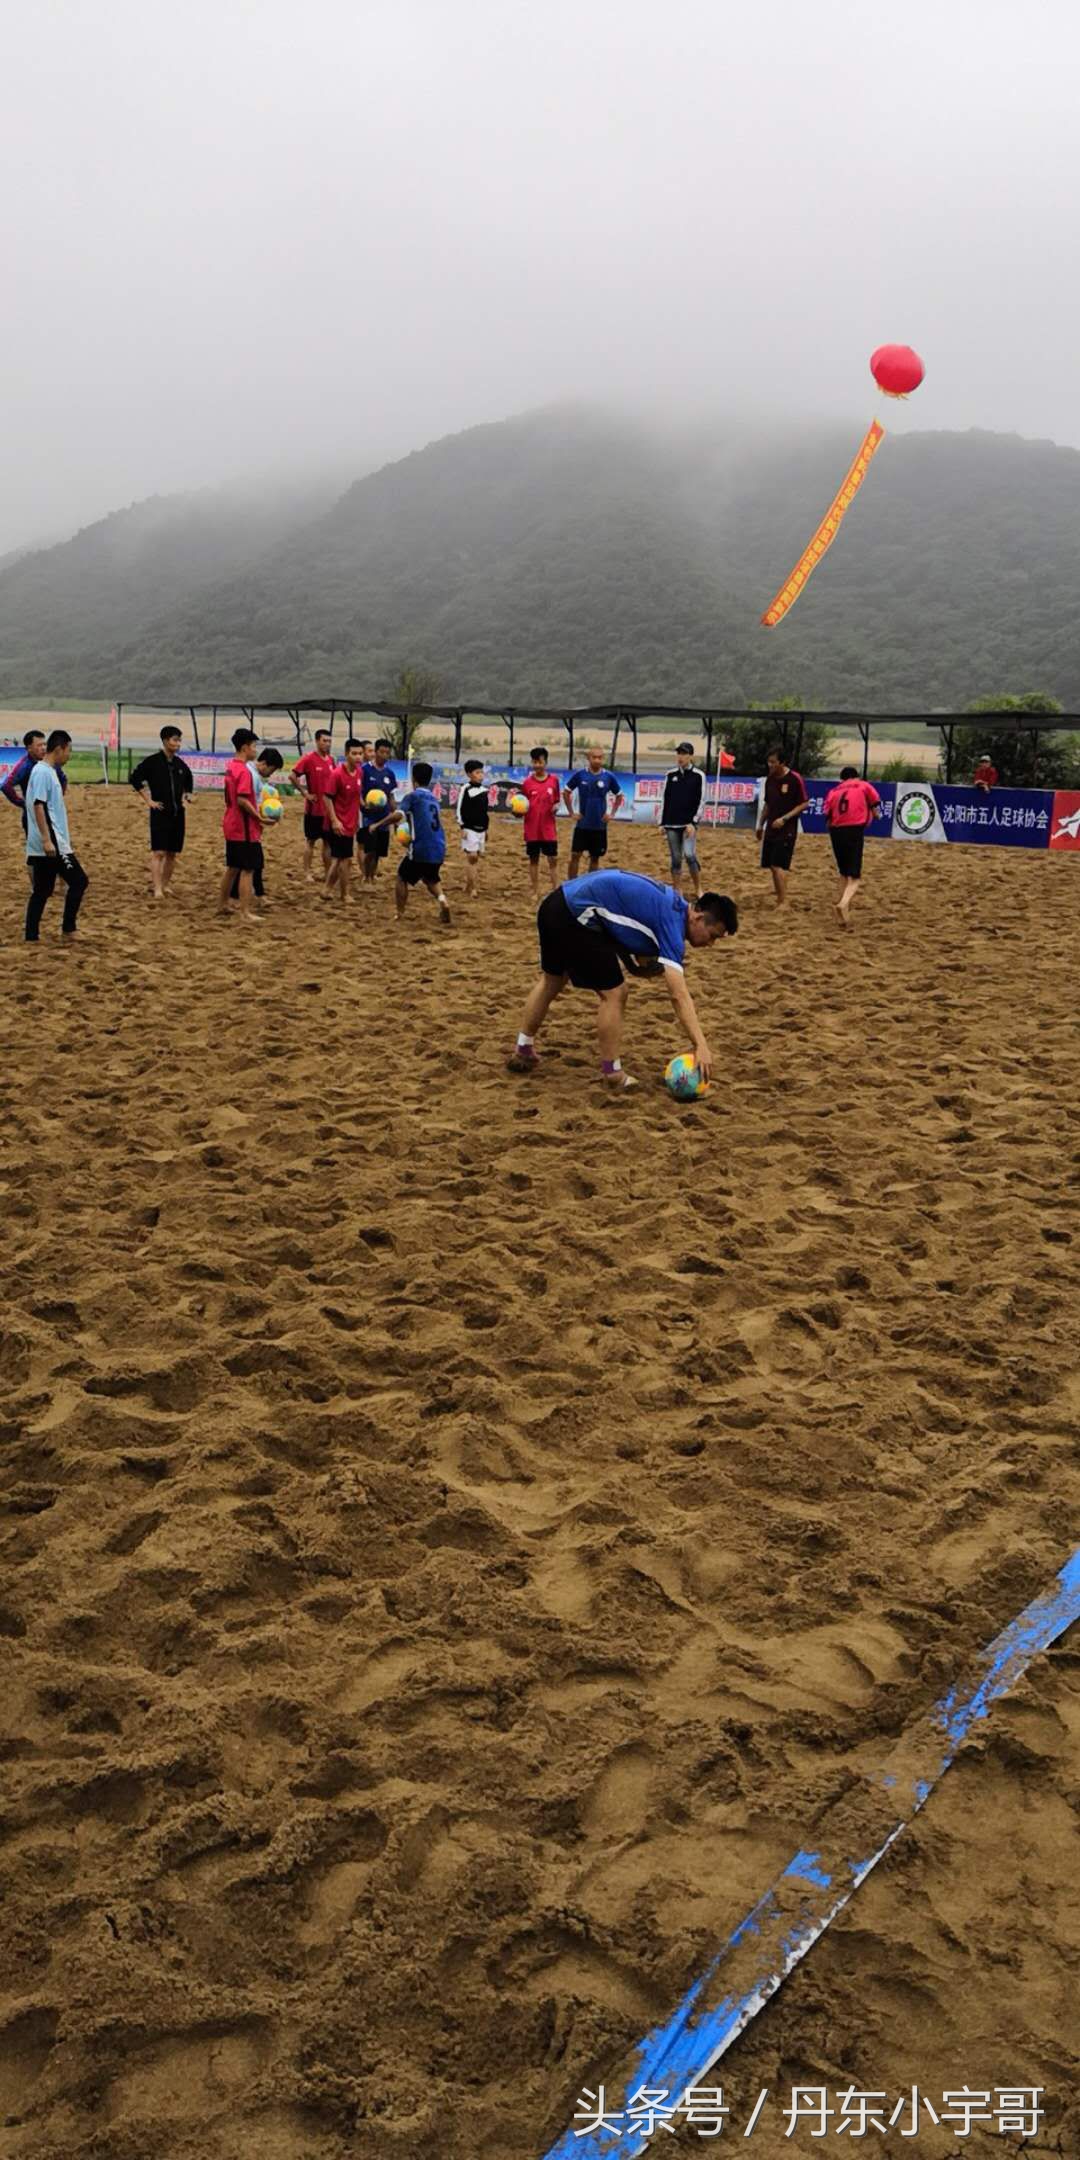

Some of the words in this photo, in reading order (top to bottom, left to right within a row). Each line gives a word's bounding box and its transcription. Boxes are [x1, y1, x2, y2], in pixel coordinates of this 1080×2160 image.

[838, 791, 849, 816] 6
[429, 803, 441, 832] 3
[943, 804, 1049, 829] 沈阳市五人足球协会
